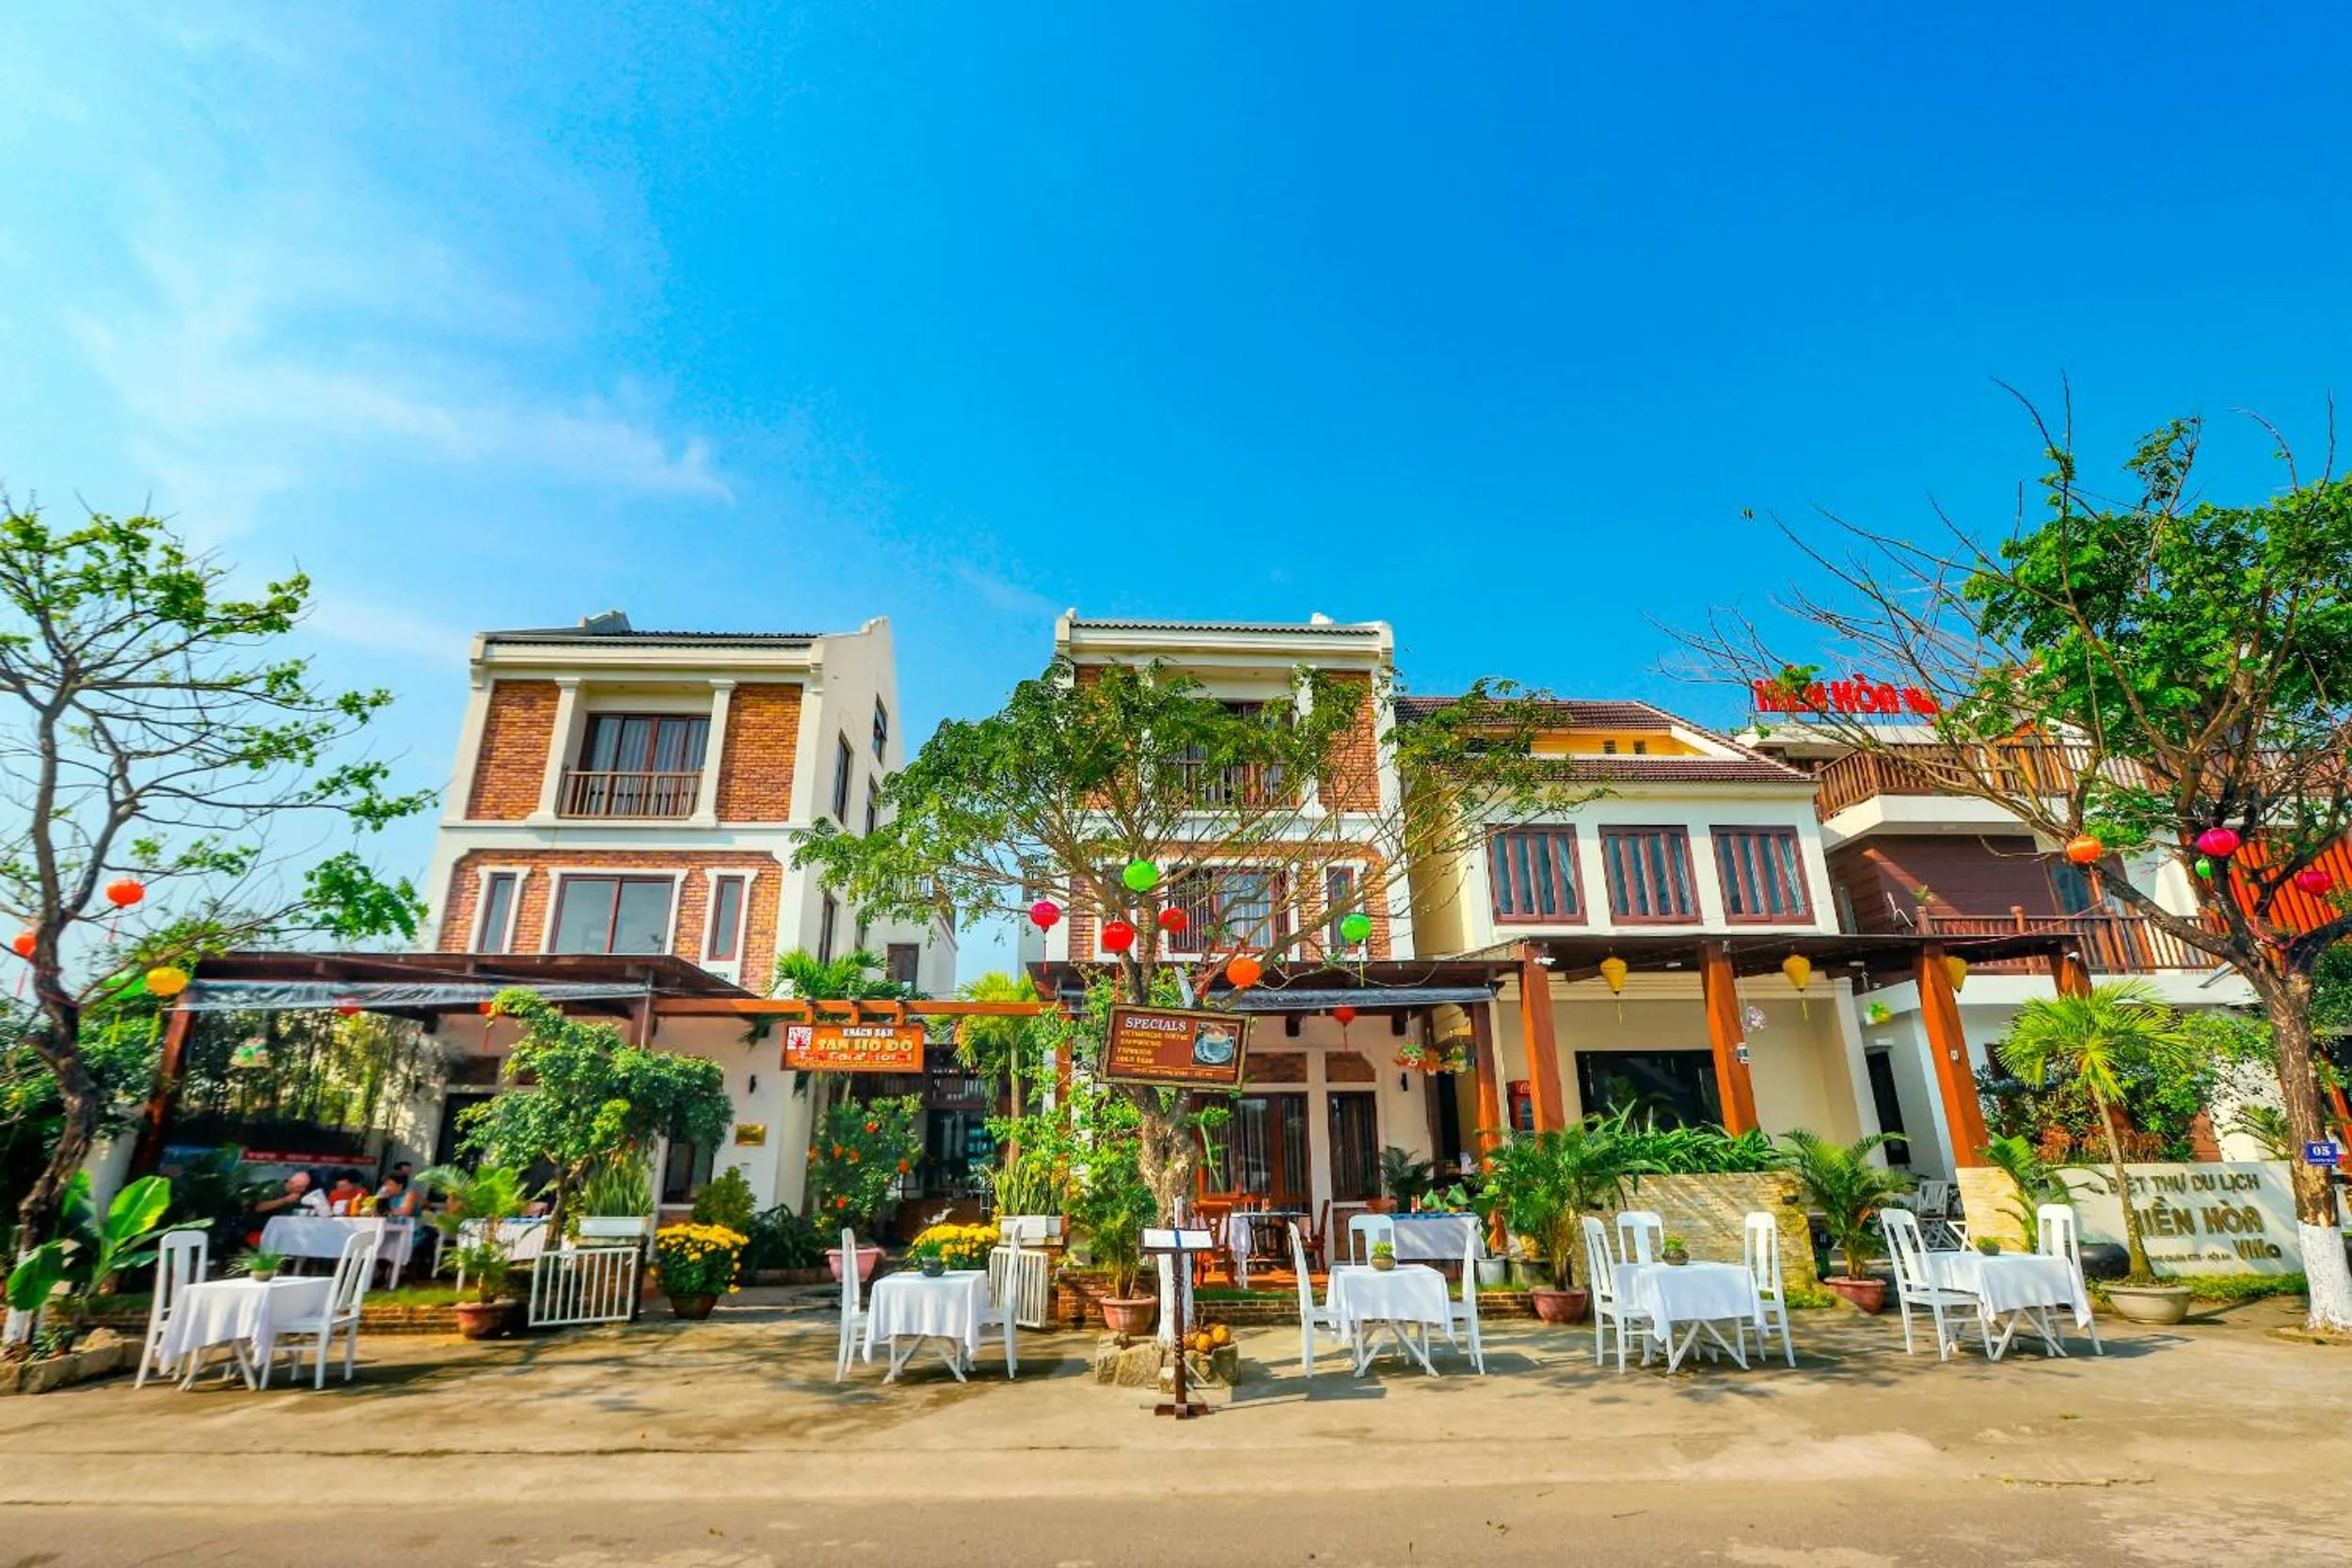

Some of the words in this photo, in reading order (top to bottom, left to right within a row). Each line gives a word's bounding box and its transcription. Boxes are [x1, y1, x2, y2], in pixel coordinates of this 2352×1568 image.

[1125, 1017, 1186, 1032] SPECIALS
[843, 1028, 872, 1037] KHÁCH
[818, 1038, 850, 1052] SAN
[2312, 1146, 2330, 1156] 05
[2190, 1174, 2216, 1192] DU
[2219, 1173, 2261, 1194] LỊCH
[2199, 1199, 2265, 1234] HÒA
